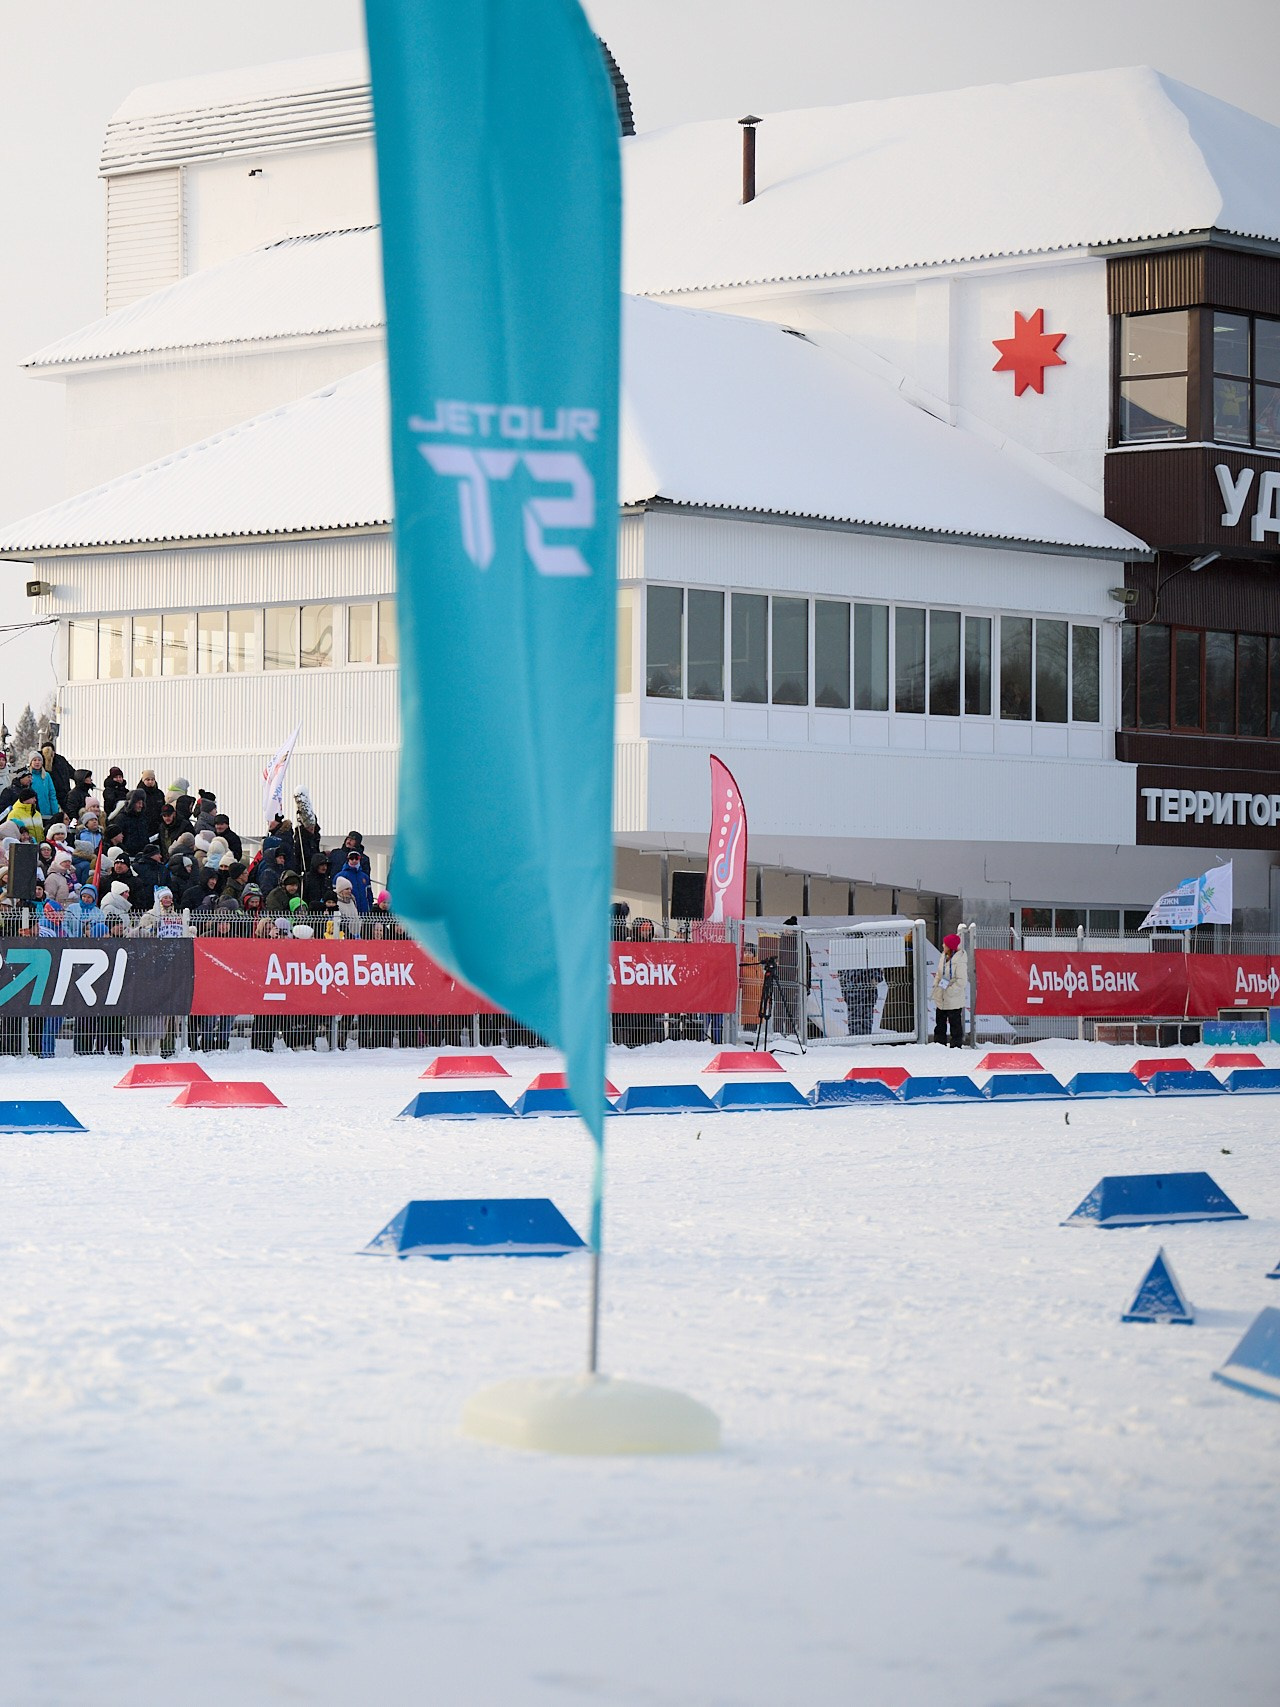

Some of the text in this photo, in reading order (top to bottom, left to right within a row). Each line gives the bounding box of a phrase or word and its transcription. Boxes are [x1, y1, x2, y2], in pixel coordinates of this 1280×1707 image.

[408, 399, 600, 442] JETOUR
[417, 443, 596, 577] T2
[264, 953, 416, 994] Альфа Банк
[618, 955, 678, 986] Банк
[1028, 963, 1140, 999] Альфа Банк
[1230, 1030, 1237, 1041] 2
